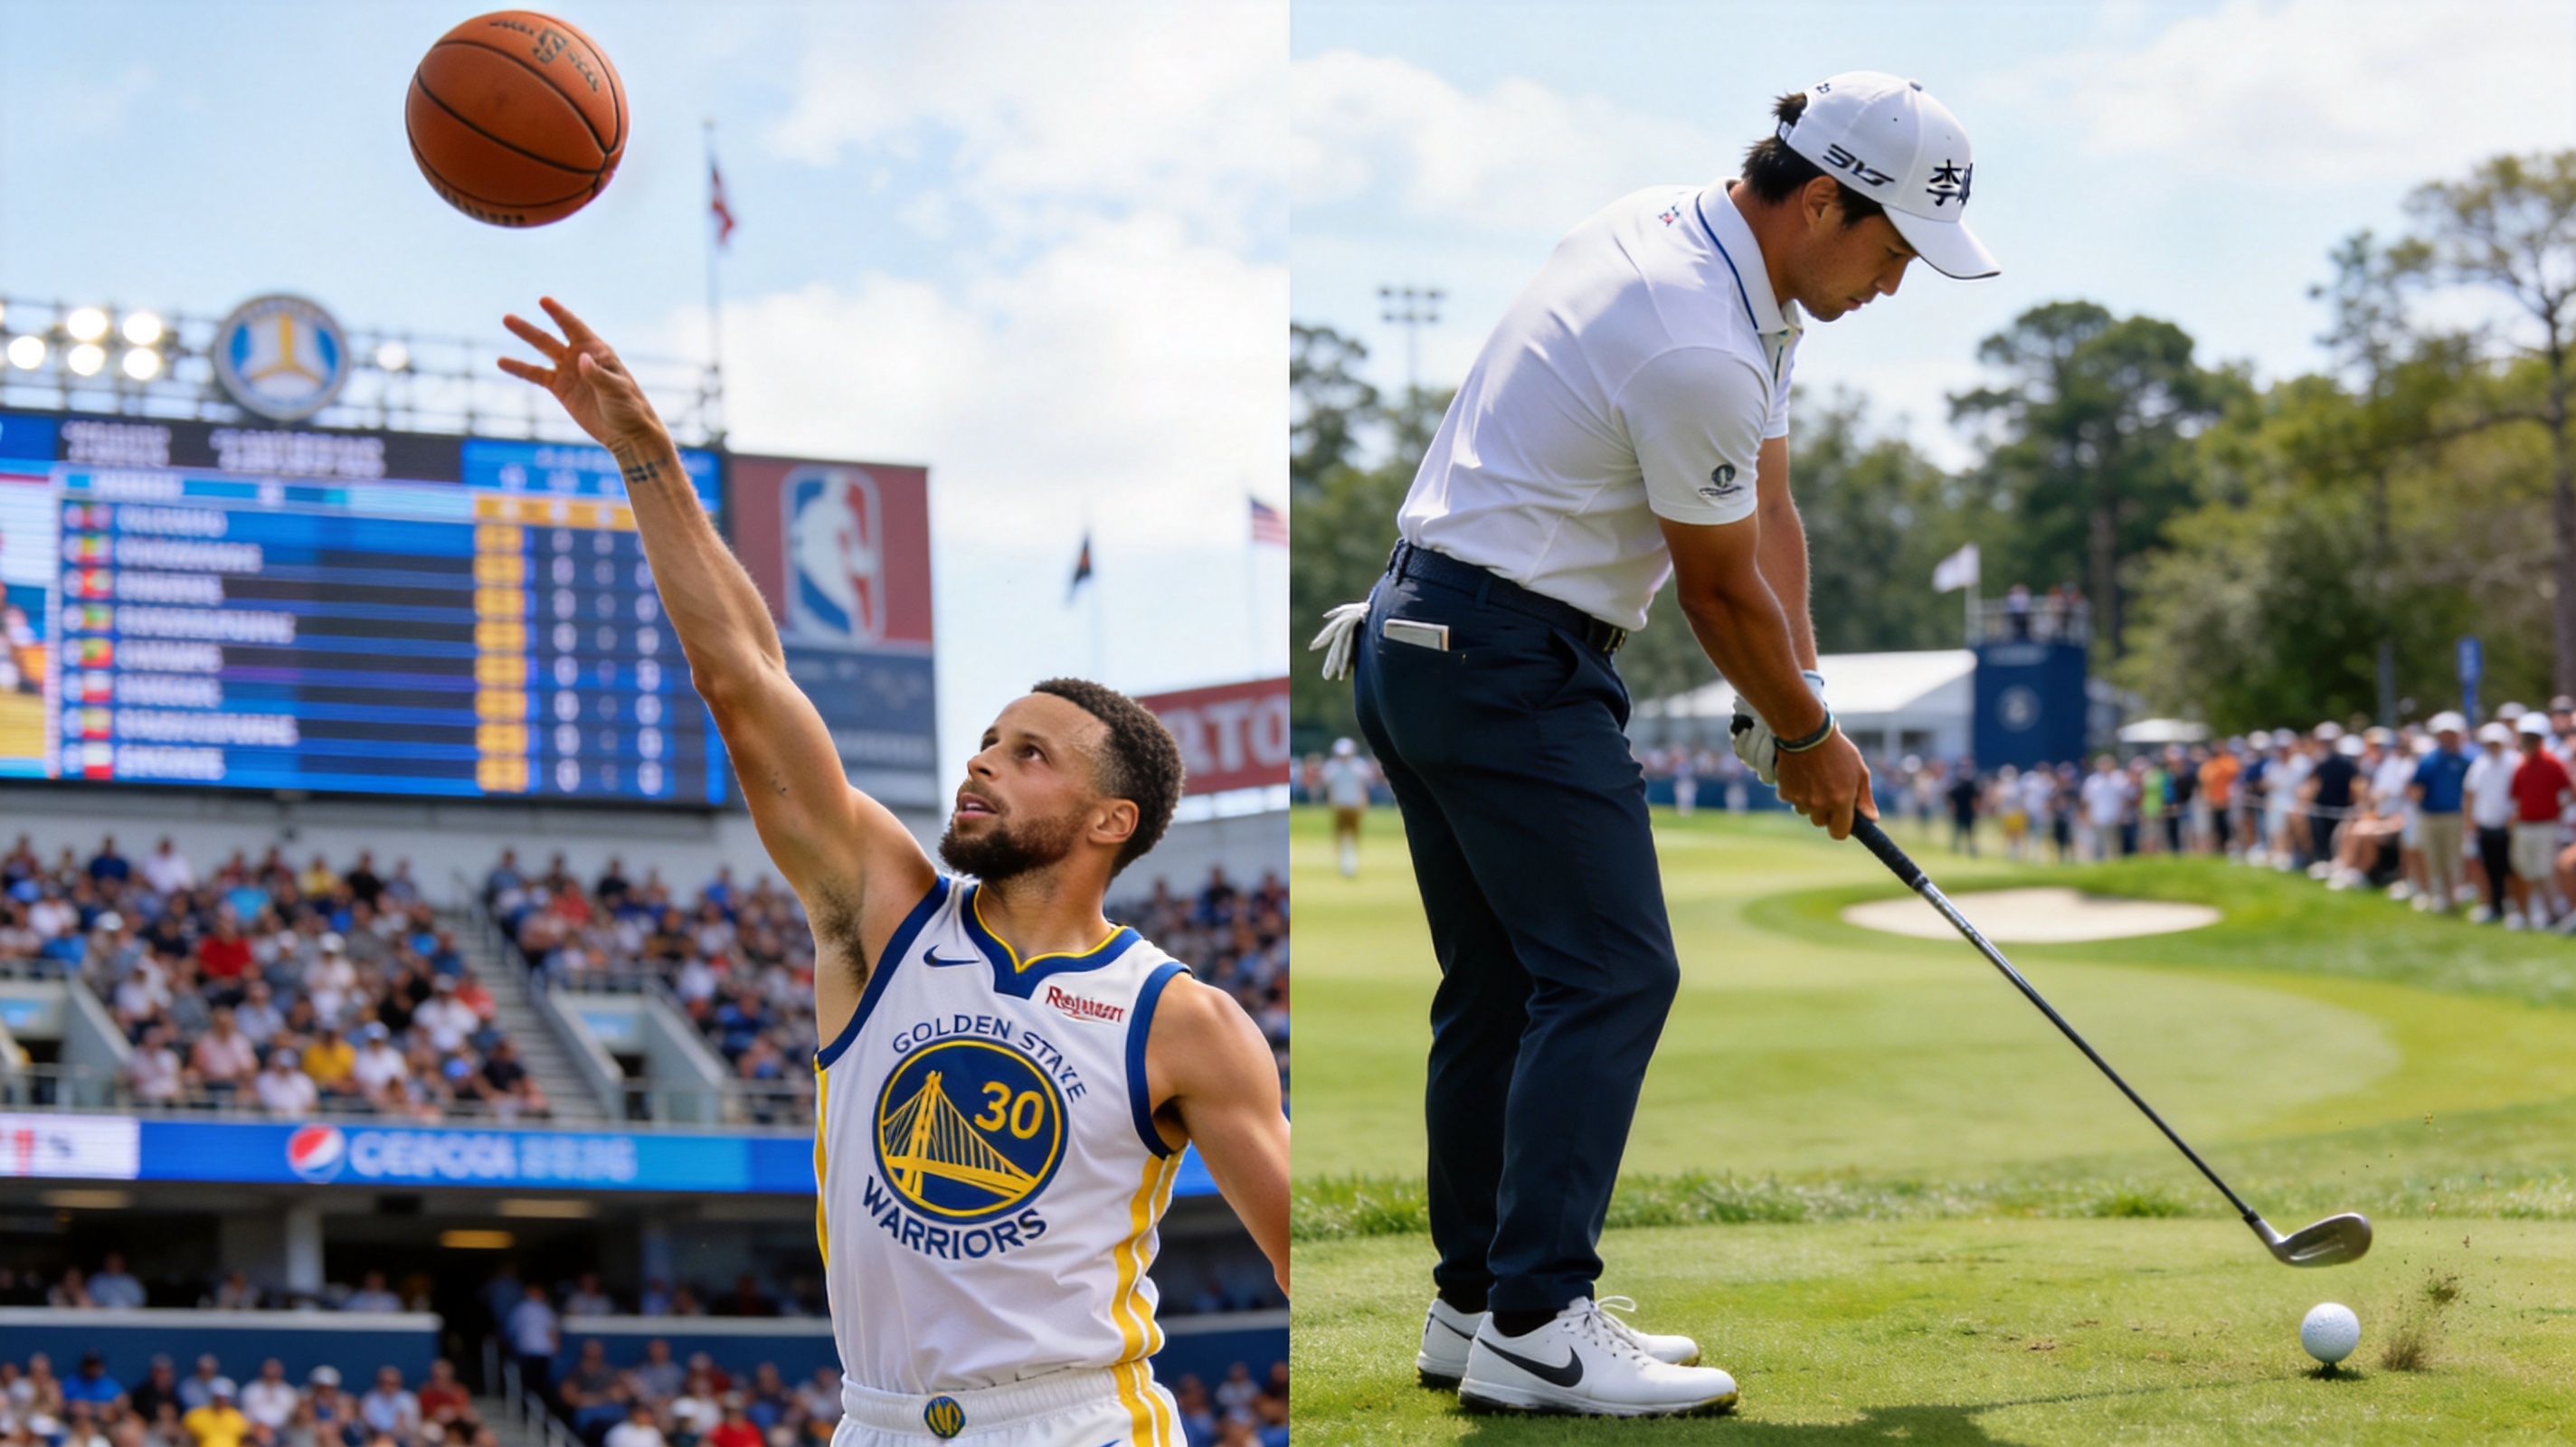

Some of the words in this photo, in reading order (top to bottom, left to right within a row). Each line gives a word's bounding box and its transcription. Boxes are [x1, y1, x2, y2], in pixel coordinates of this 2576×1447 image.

[893, 1014, 1011, 1054] GOLDEN
[974, 1081, 1045, 1140] 30
[863, 1175, 1046, 1260] WARRIORS
